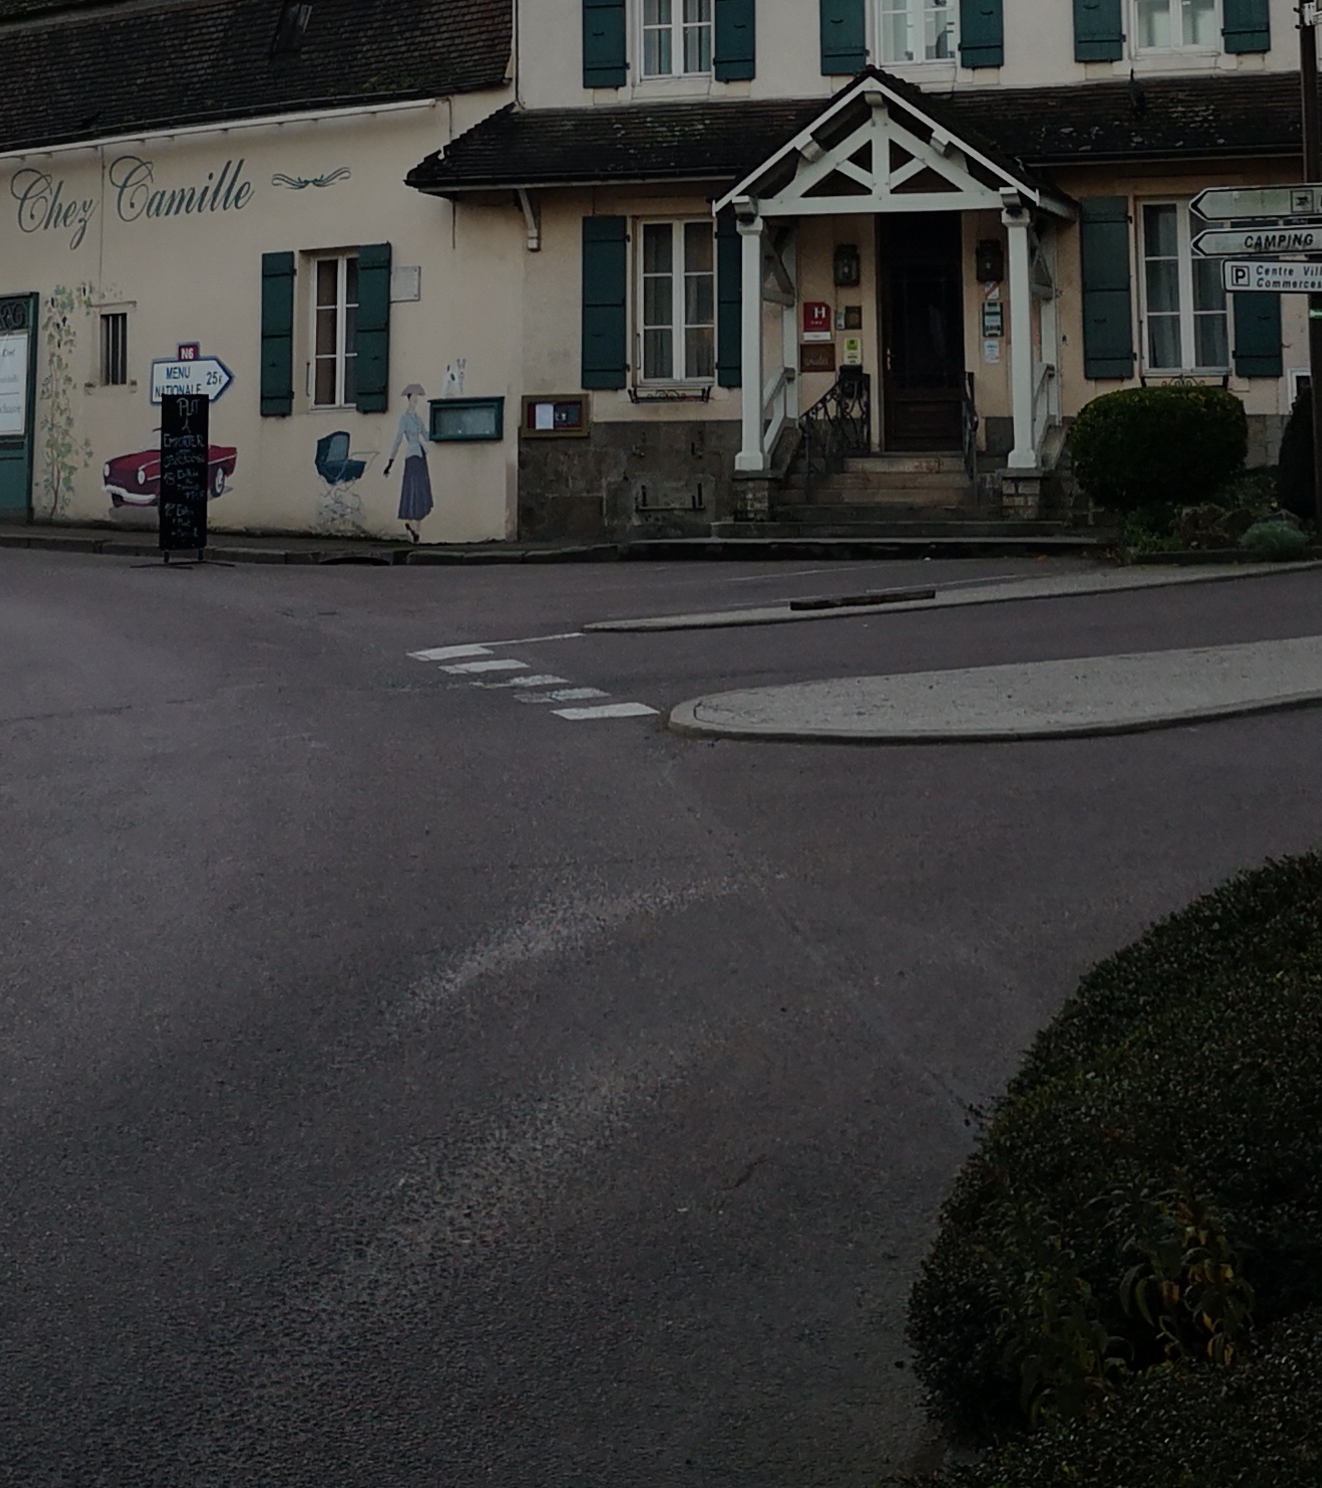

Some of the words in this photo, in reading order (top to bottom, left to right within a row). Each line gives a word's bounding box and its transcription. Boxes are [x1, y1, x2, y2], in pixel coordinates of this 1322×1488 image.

[10, 168, 99, 251] Chez
[109, 155, 254, 222] Camille
[1244, 234, 1314, 249] CAMPING
[1256, 265, 1294, 277] Centre
[1256, 278, 1322, 289] Commerces
[180, 347, 195, 360] N6
[166, 366, 191, 379] MENU
